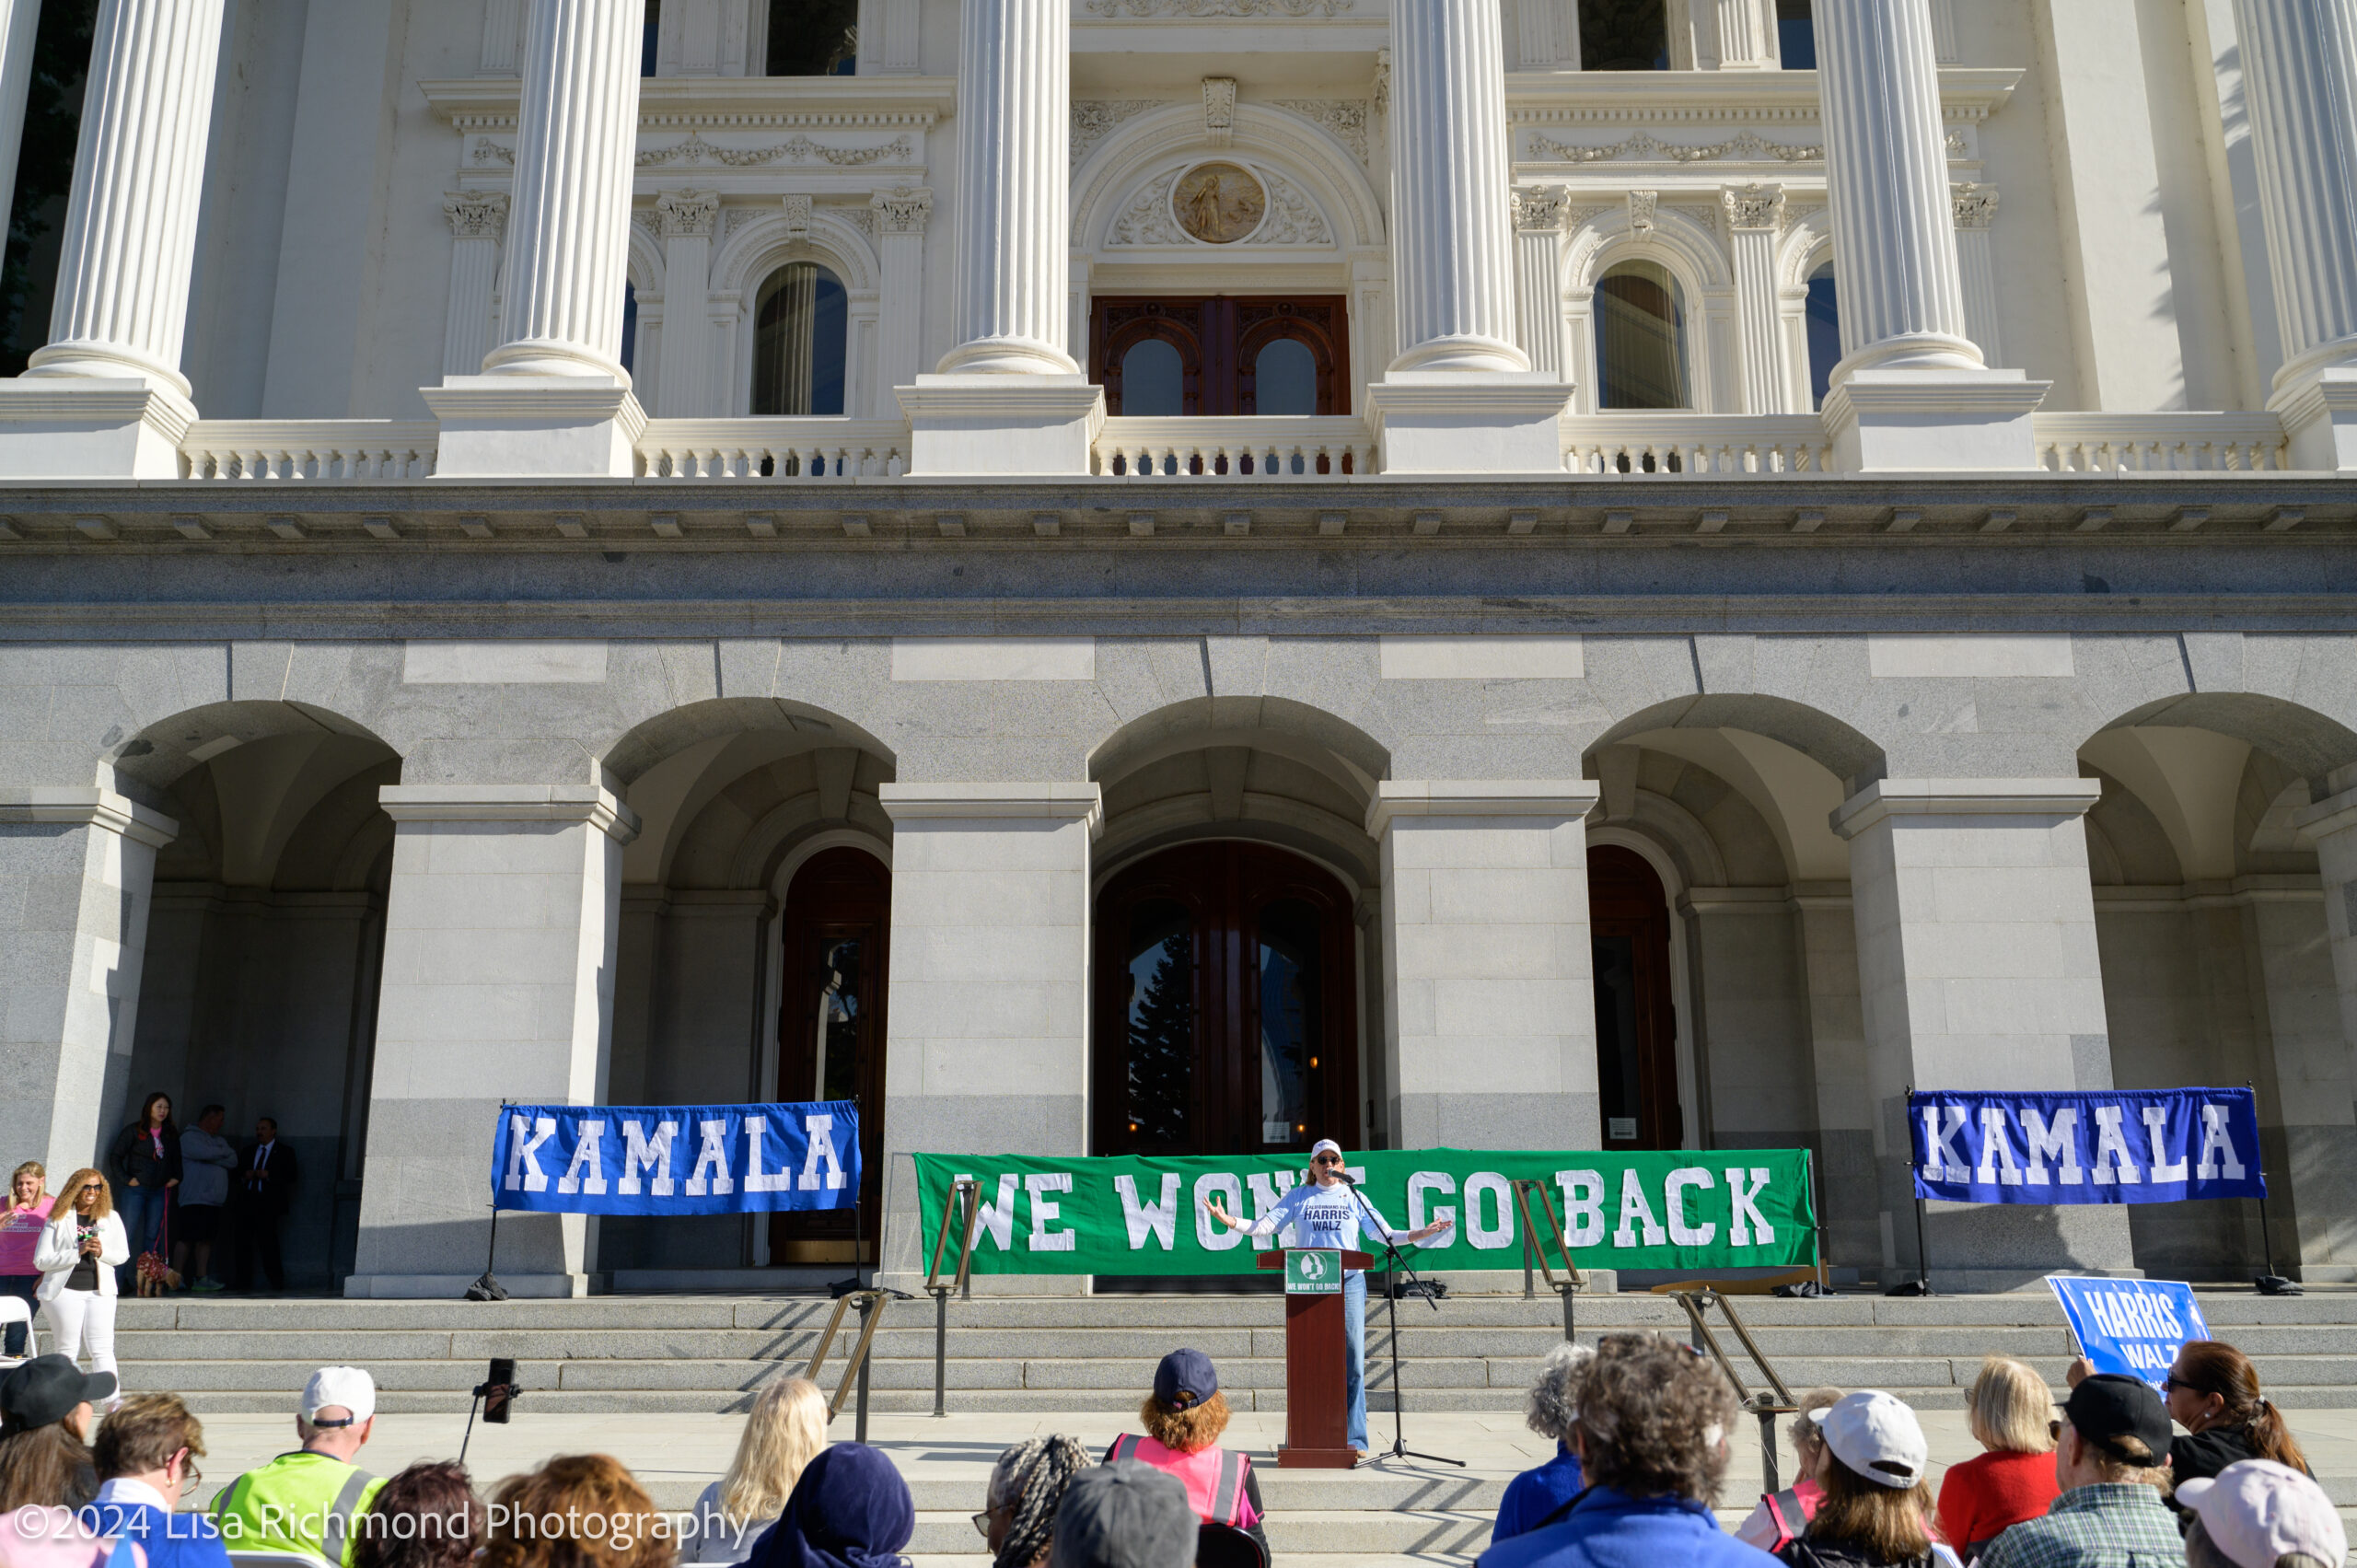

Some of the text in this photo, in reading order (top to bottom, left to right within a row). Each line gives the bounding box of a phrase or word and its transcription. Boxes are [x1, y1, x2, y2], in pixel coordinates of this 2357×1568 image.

[505, 1114, 847, 1196] KAMALA
[1922, 1105, 2246, 1186] KAMALA
[954, 1172, 1075, 1252] WE
[1408, 1170, 1515, 1250] GO
[1554, 1167, 1776, 1249] BACK
[1304, 1210, 1350, 1220] HARRIS
[1312, 1220, 1341, 1231] WALZ
[2084, 1291, 2184, 1340] HARRIS
